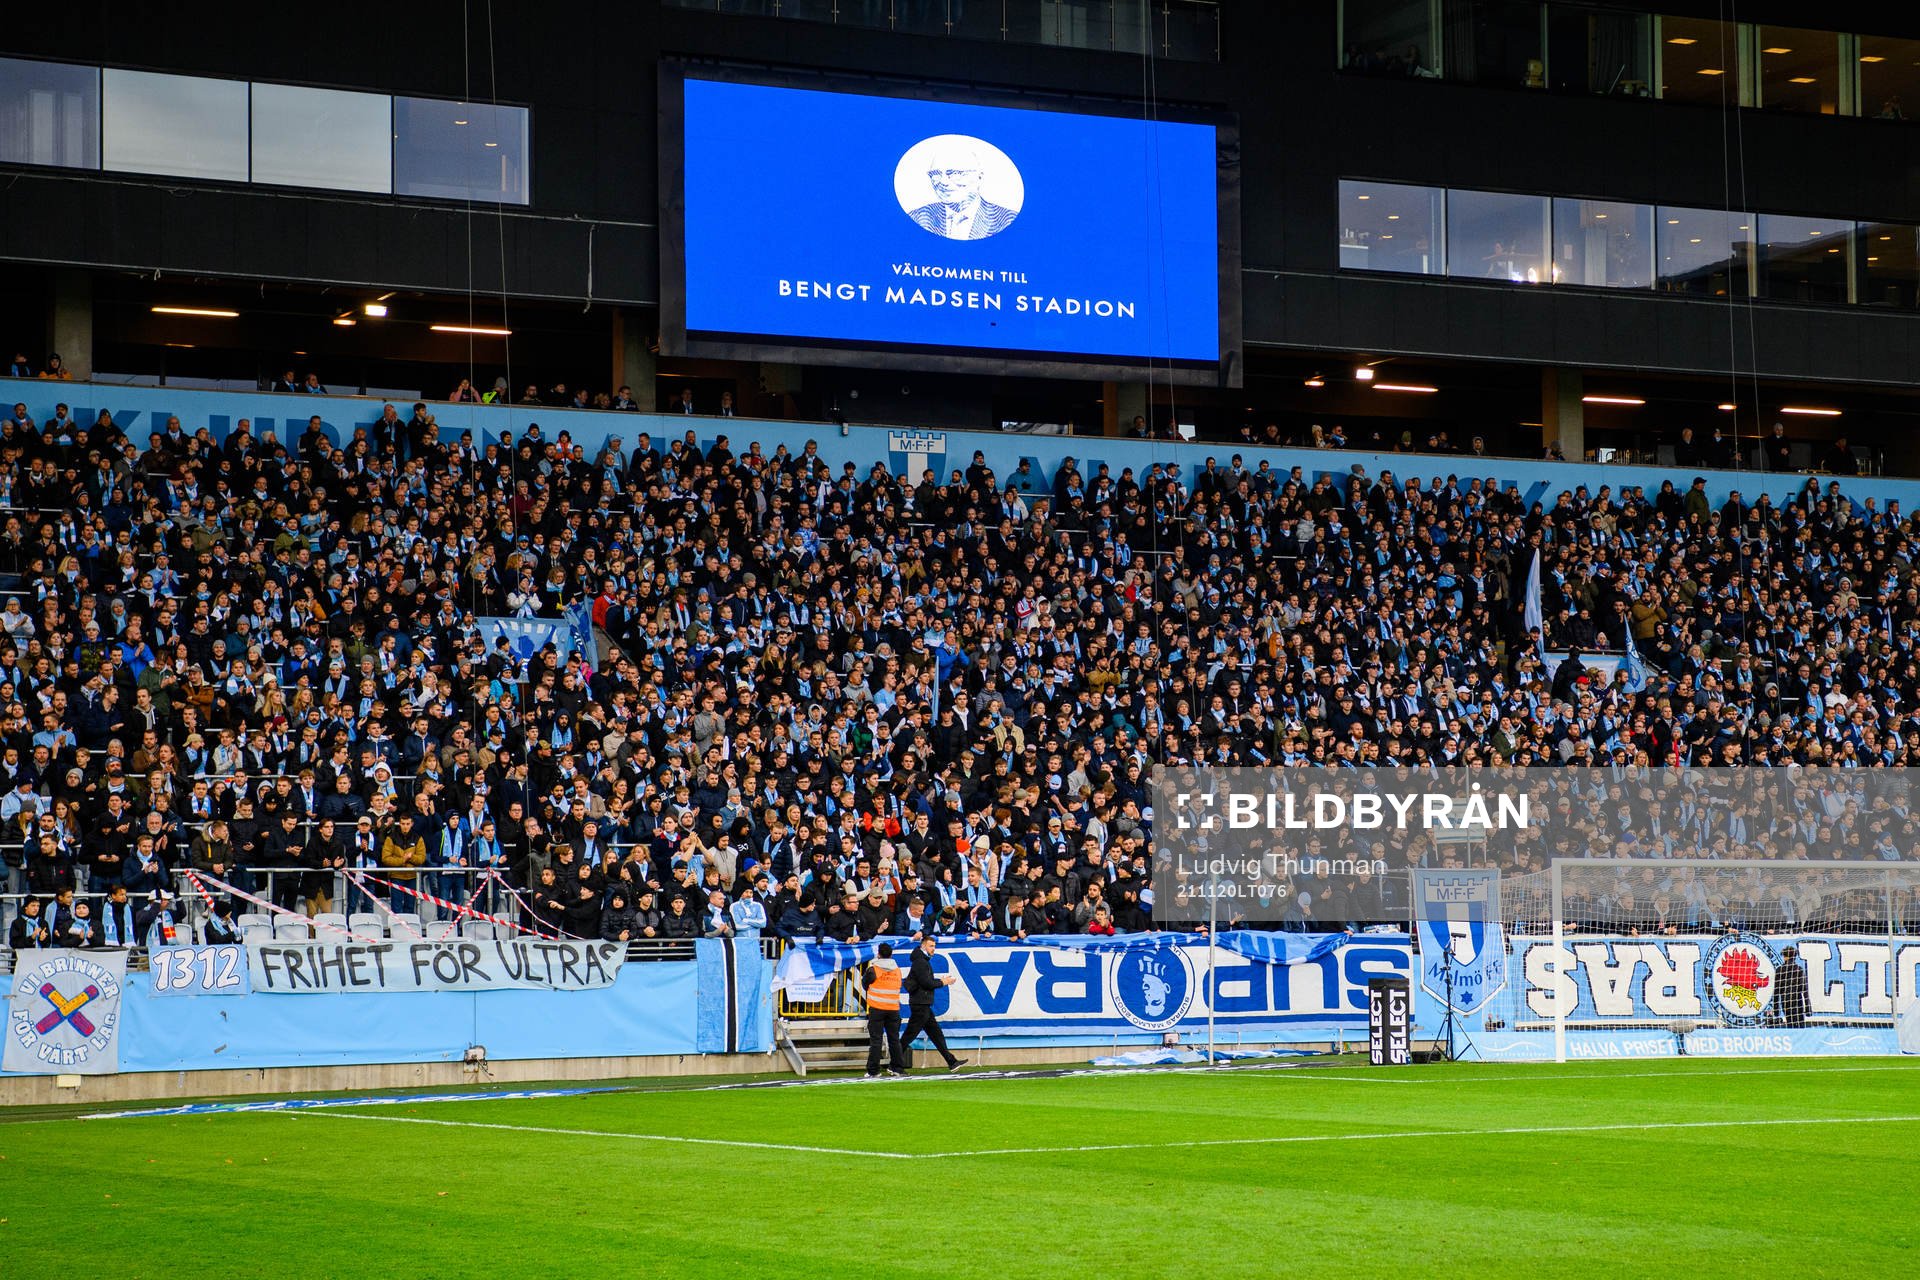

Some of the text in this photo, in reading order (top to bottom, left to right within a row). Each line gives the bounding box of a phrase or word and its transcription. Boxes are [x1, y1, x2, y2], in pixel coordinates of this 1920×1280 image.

[892, 263, 1028, 284] VÄLKOMMEN TILL
[779, 279, 1135, 318] BENGT MADSEN STADION
[19, 956, 120, 1000] VI BRINNER
[152, 946, 241, 992] 1312
[259, 943, 394, 989] FRIHET
[410, 942, 492, 986] FÖR
[12, 1009, 116, 1065] FÖR VÅRT LAG
[1371, 990, 1383, 1065] SELECT
[1390, 989, 1407, 1064] SELECT
[1569, 1035, 1793, 1057] HALVA PRISET MED BROPASS
